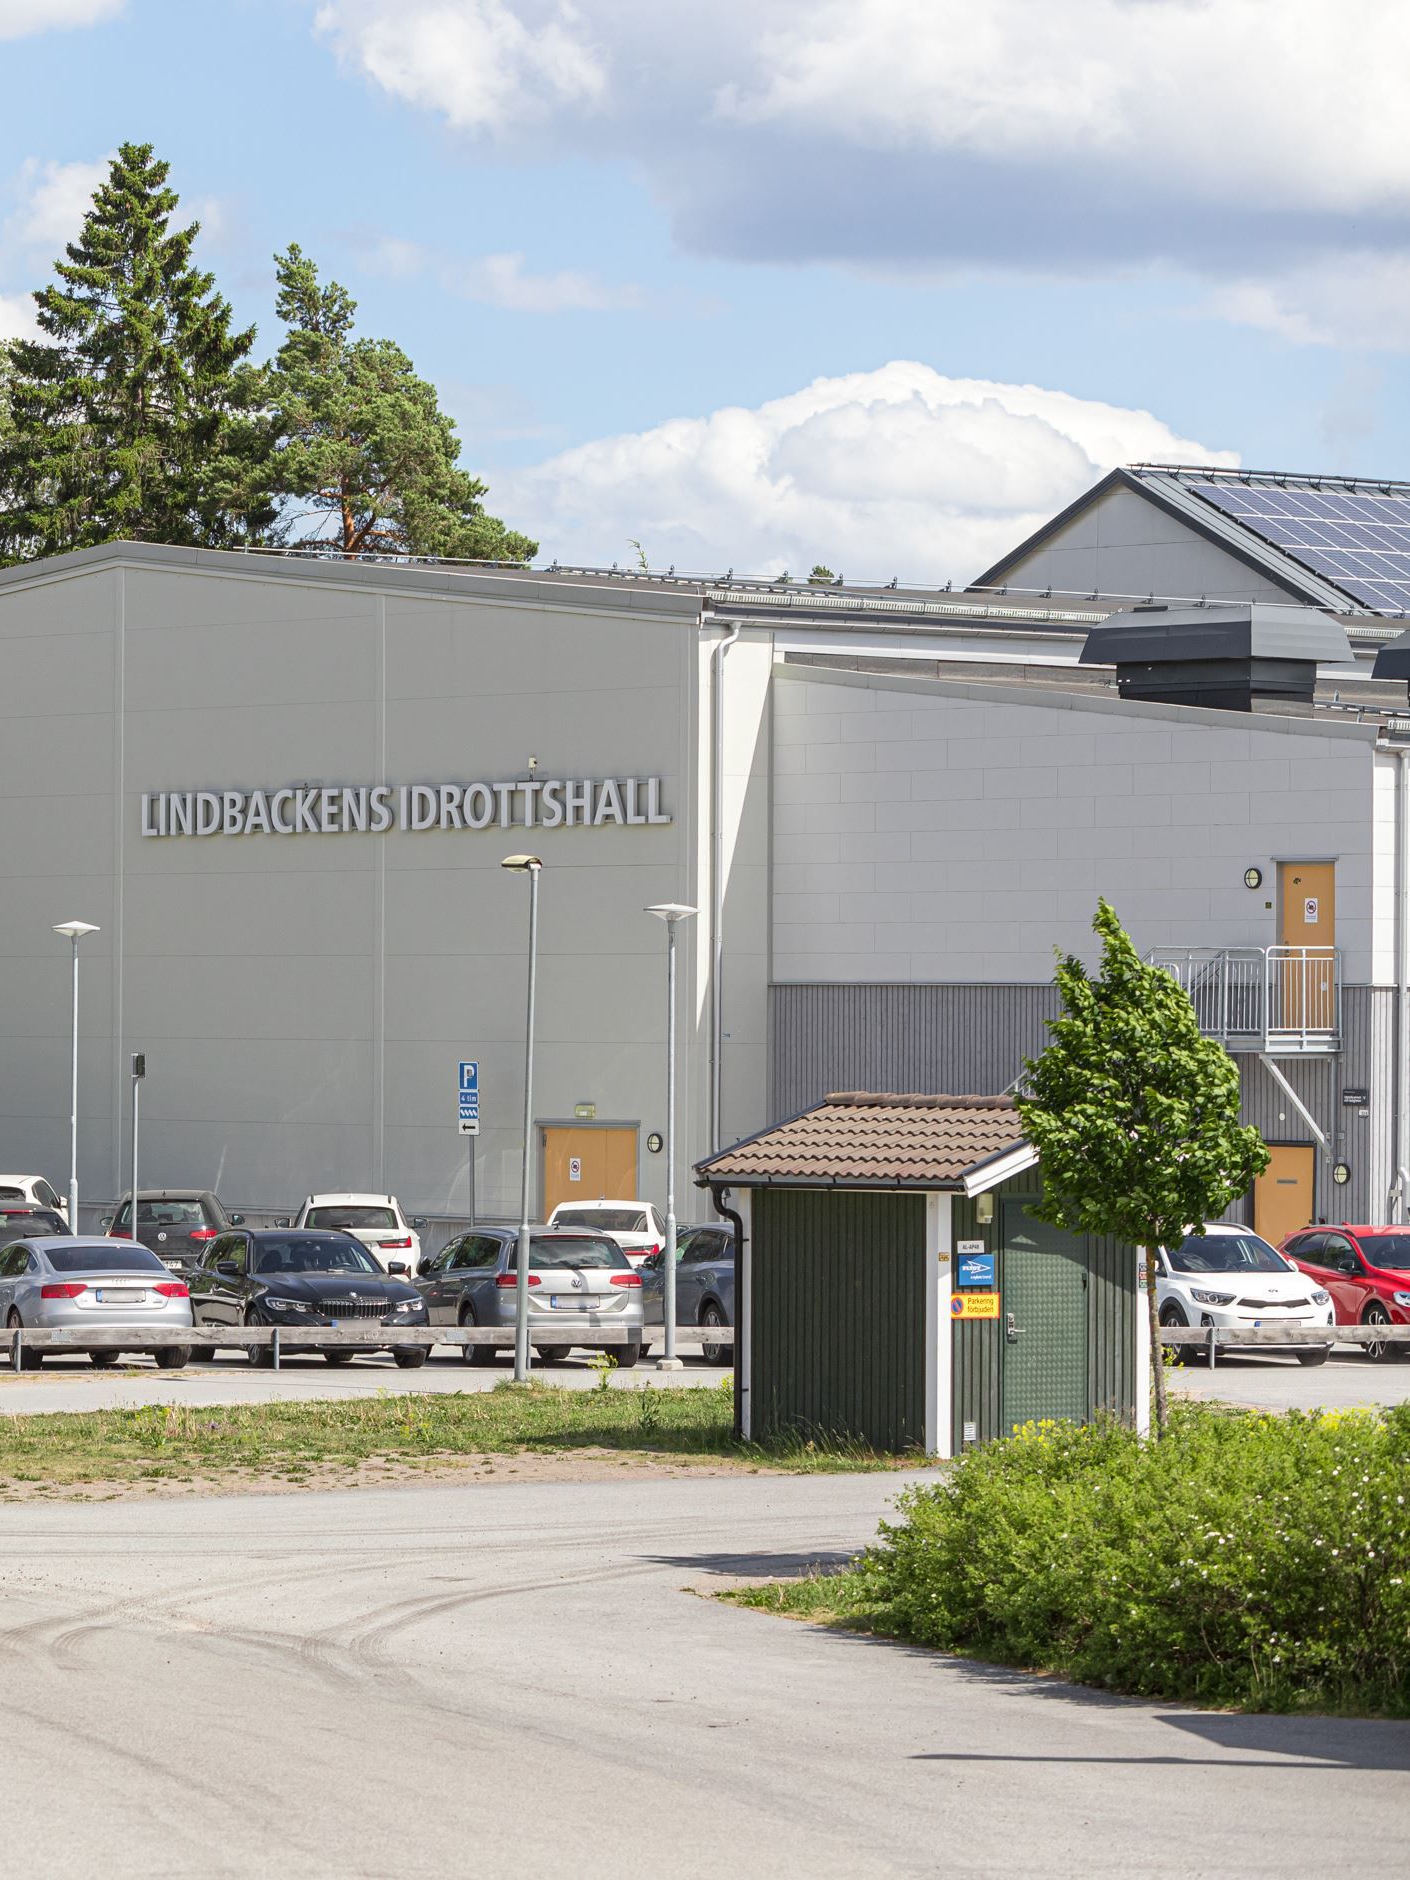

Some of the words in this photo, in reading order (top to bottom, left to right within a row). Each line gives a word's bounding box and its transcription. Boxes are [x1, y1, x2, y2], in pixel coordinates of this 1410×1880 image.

[140, 784, 394, 838] LINDBACKENS
[398, 777, 672, 832] IDROTTSHALL
[463, 1065, 475, 1088] P
[967, 1297, 994, 1306] Parkering
[967, 1305, 994, 1314] förbjuden
